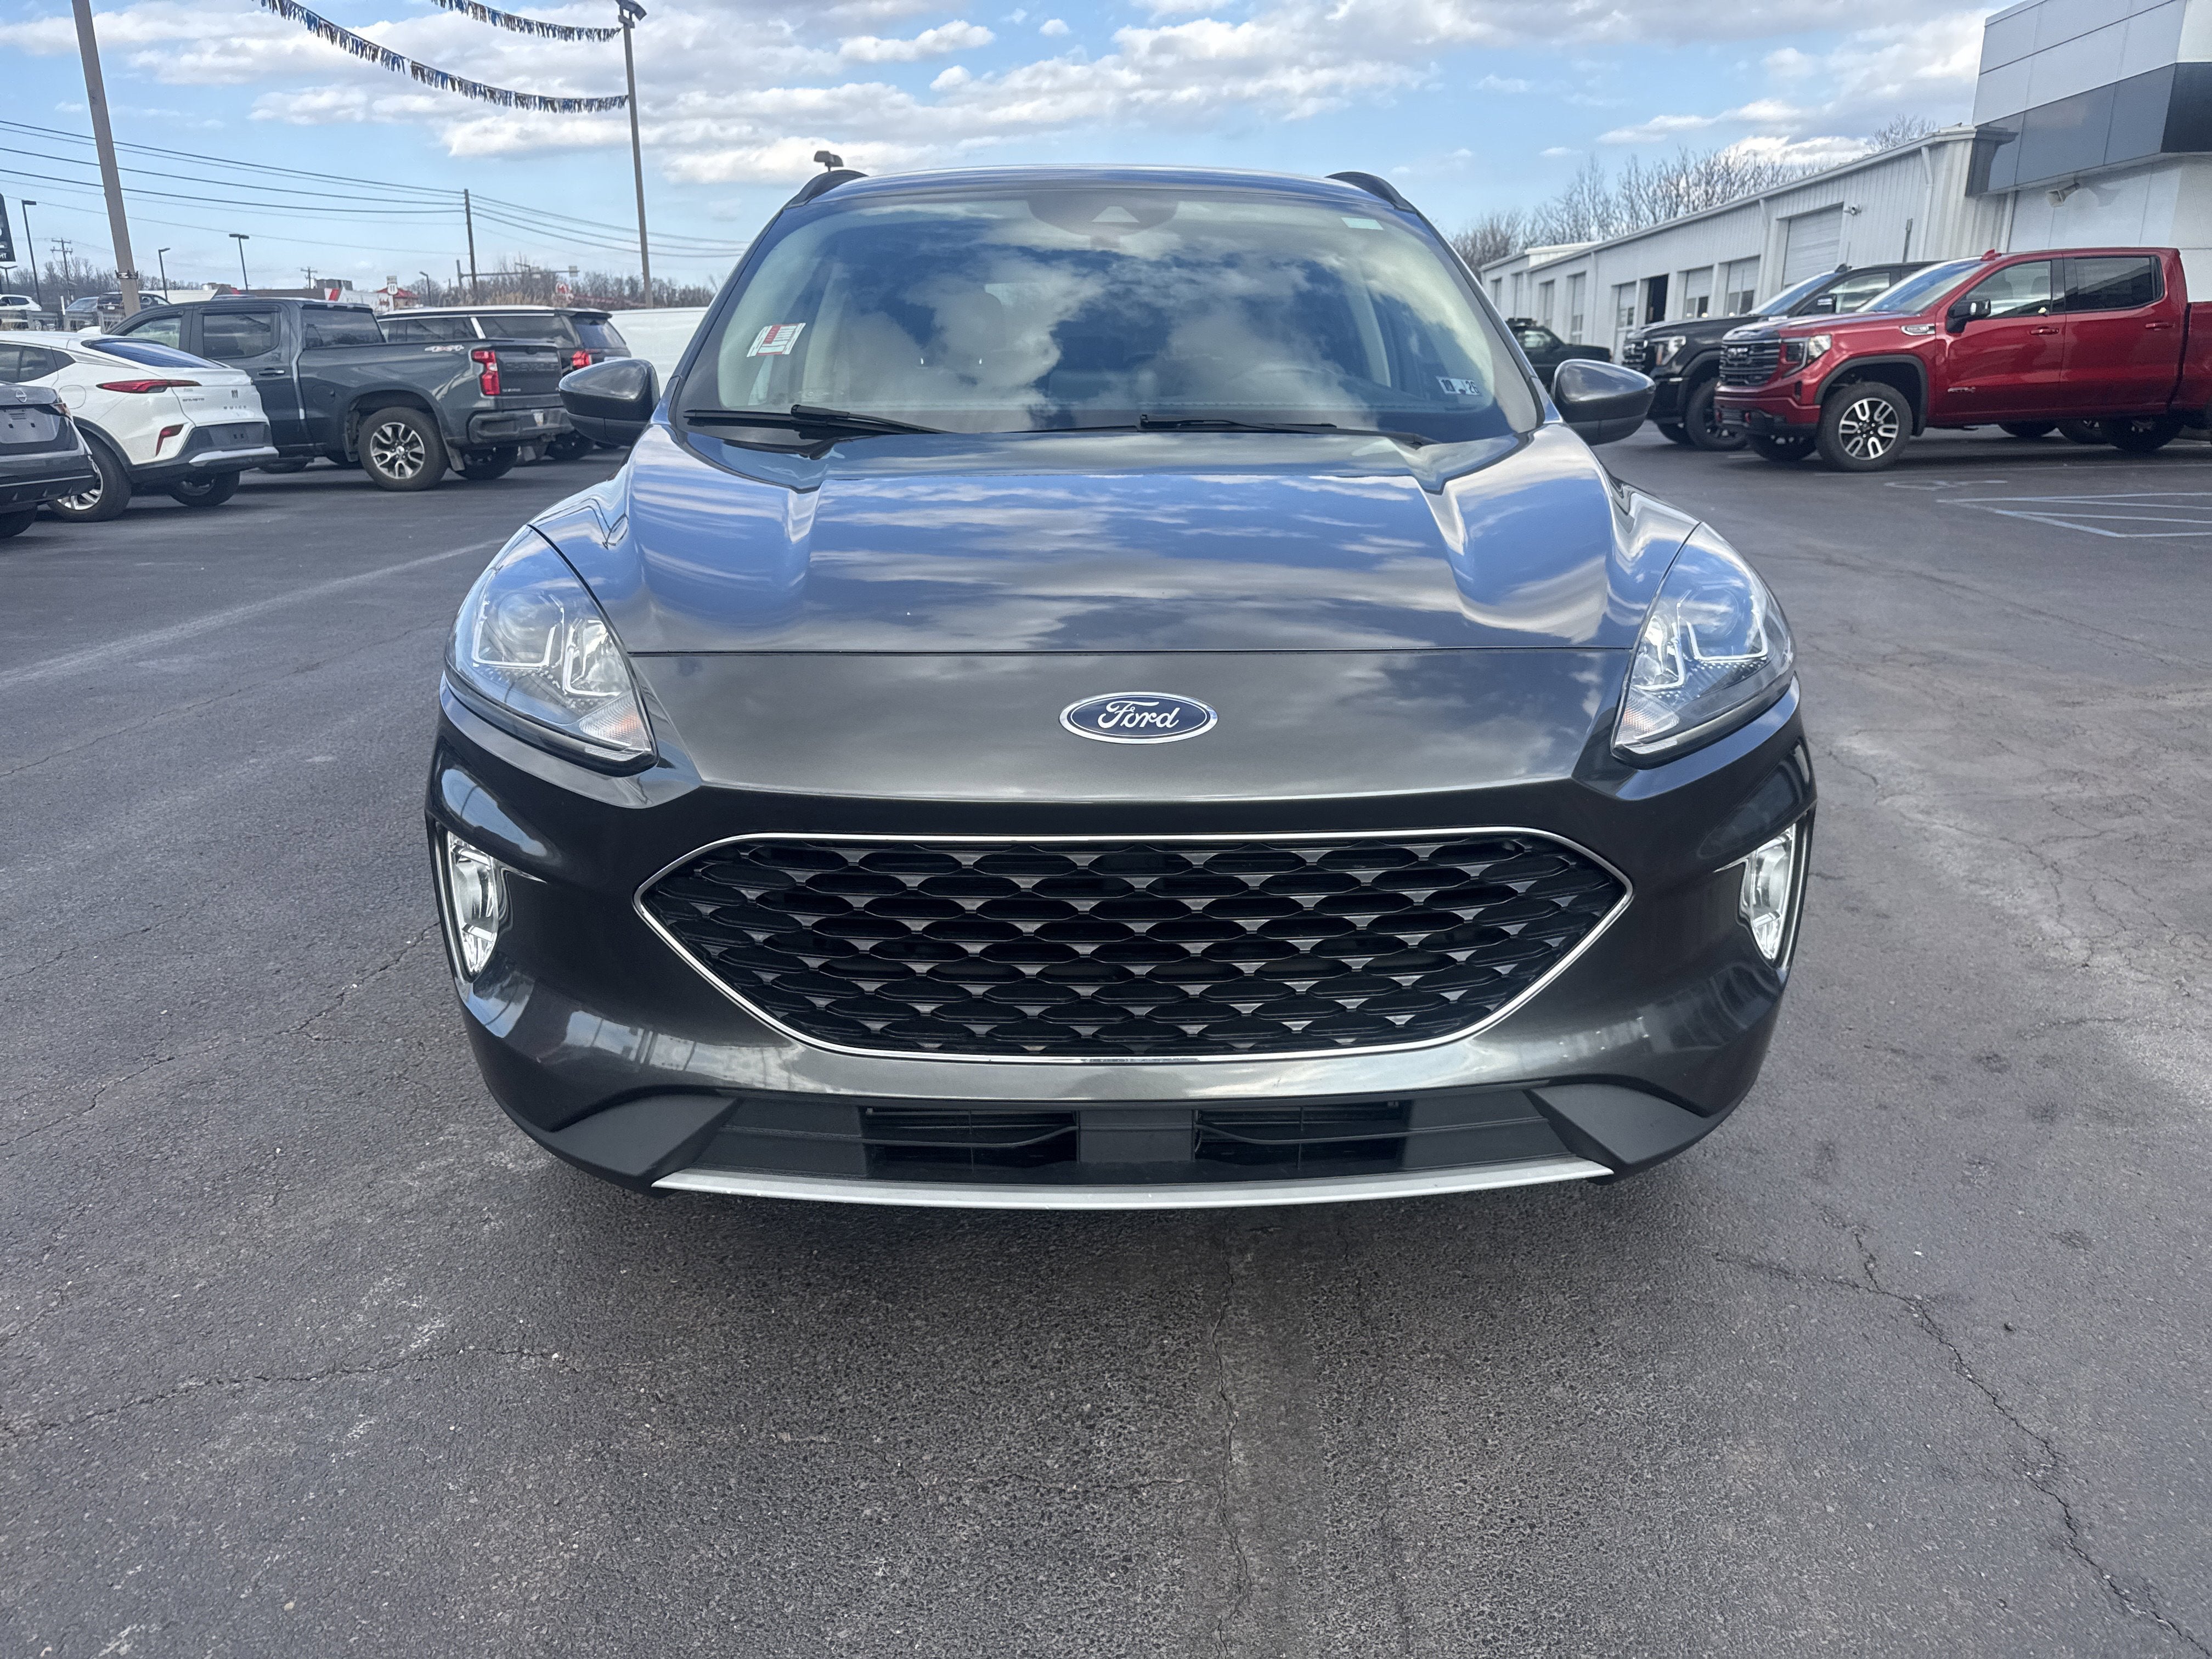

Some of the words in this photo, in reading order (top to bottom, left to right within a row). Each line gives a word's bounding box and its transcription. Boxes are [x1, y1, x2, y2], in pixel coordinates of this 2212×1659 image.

[1441, 379, 1455, 392] 10
[1465, 380, 1480, 393] 26
[1097, 700, 1181, 729] Ford
